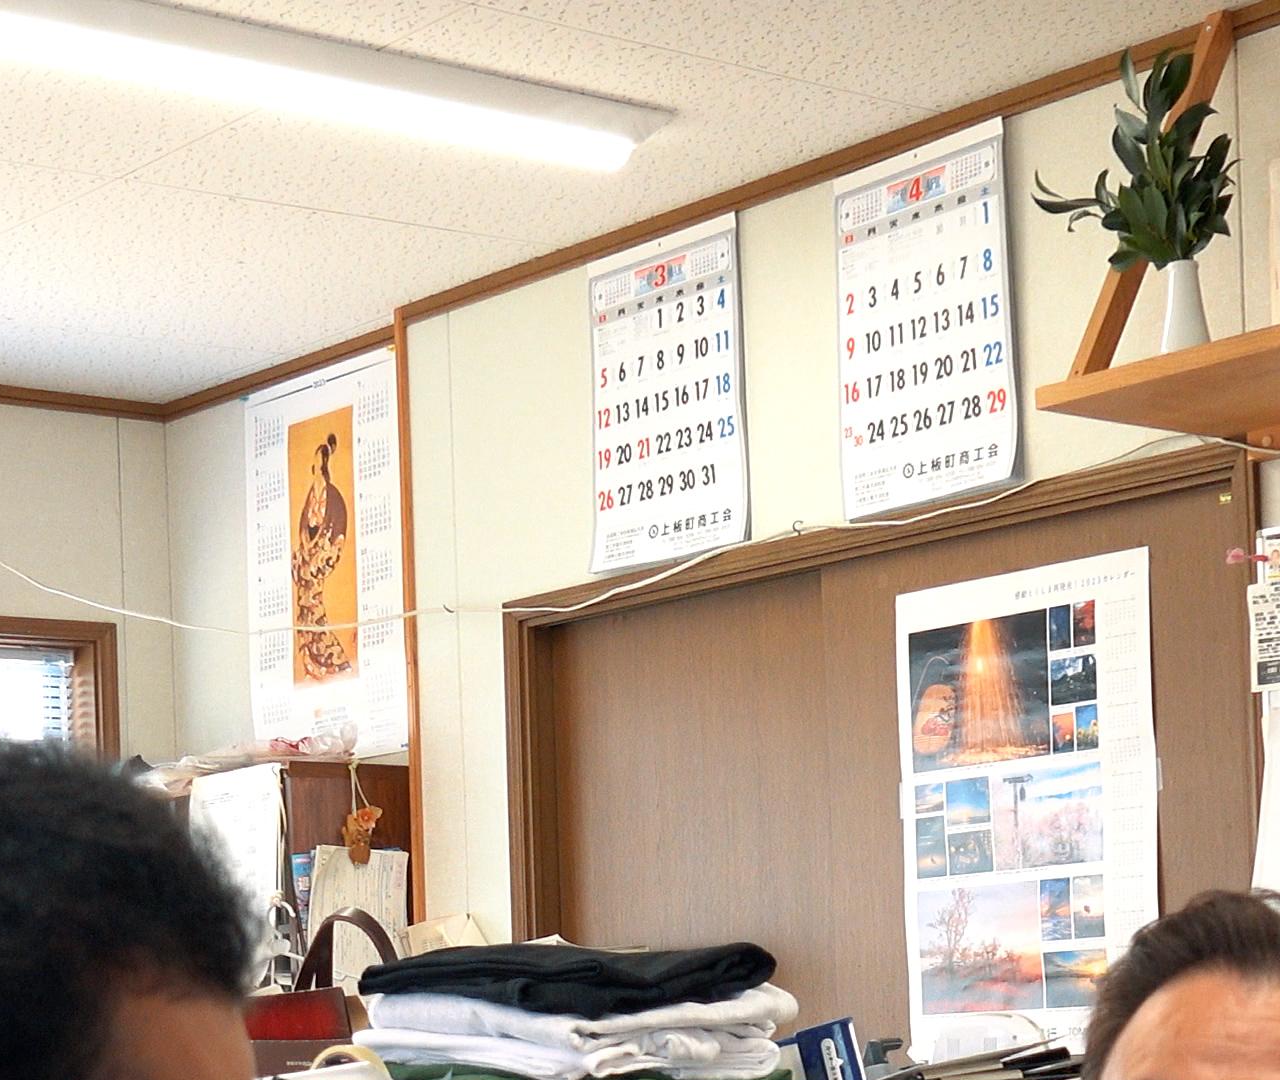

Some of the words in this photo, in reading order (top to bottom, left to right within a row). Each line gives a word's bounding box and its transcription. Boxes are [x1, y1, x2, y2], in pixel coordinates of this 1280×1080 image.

[909, 177, 923, 200] 4
[982, 201, 989, 224] 1
[654, 264, 667, 288] 3
[846, 293, 855, 315] 2
[868, 285, 877, 308] 3
[890, 278, 900, 300] 4
[913, 270, 922, 294] 5
[936, 263, 945, 286] 6
[960, 255, 968, 280] 7
[982, 248, 993, 272] 8
[657, 308, 663, 329] 1
[676, 301, 684, 323] 2
[696, 295, 705, 317] 3
[717, 288, 726, 309] 4
[846, 337, 855, 359] 9
[865, 330, 882, 354] 10
[889, 322, 904, 347] 11
[910, 315, 927, 340] 12
[933, 308, 951, 334] 13
[957, 301, 975, 327] 14
[981, 293, 999, 320] 15
[600, 367, 608, 389] 5
[618, 361, 627, 382] 6
[637, 355, 645, 377] 7
[656, 349, 665, 371] 8
[676, 343, 685, 365] 9
[694, 336, 709, 360] 10
[715, 330, 729, 353] 11
[844, 381, 860, 404] 16
[866, 374, 882, 399] 17
[889, 368, 906, 393] 18
[912, 361, 929, 386] 19
[934, 354, 954, 380] 20
[960, 347, 977, 373] 21
[983, 341, 1003, 367] 22
[597, 407, 611, 430] 12
[615, 401, 630, 425] 13
[635, 395, 649, 419] 14
[654, 390, 669, 413] 15
[674, 385, 690, 407] 16
[694, 378, 709, 401] 17
[715, 372, 731, 395] 18
[844, 427, 853, 438] 23
[867, 419, 885, 444] 24
[890, 413, 909, 438] 25
[913, 407, 933, 432] 26
[936, 400, 955, 426] 27
[961, 394, 982, 420] 28
[987, 388, 1007, 414] 29
[598, 448, 612, 470] 19
[615, 442, 632, 466] 20
[637, 437, 650, 460] 21
[655, 431, 672, 455] 22
[675, 426, 693, 450] 23
[696, 420, 714, 444] 24
[717, 415, 735, 438] 25
[917, 443, 999, 476] 上板町商工会
[598, 489, 614, 512] 26
[617, 483, 633, 507] 27
[637, 479, 654, 502] 28
[657, 474, 674, 497] 29
[678, 468, 696, 492] 30
[701, 463, 716, 486] 31
[661, 507, 732, 537] 上板町商工会
